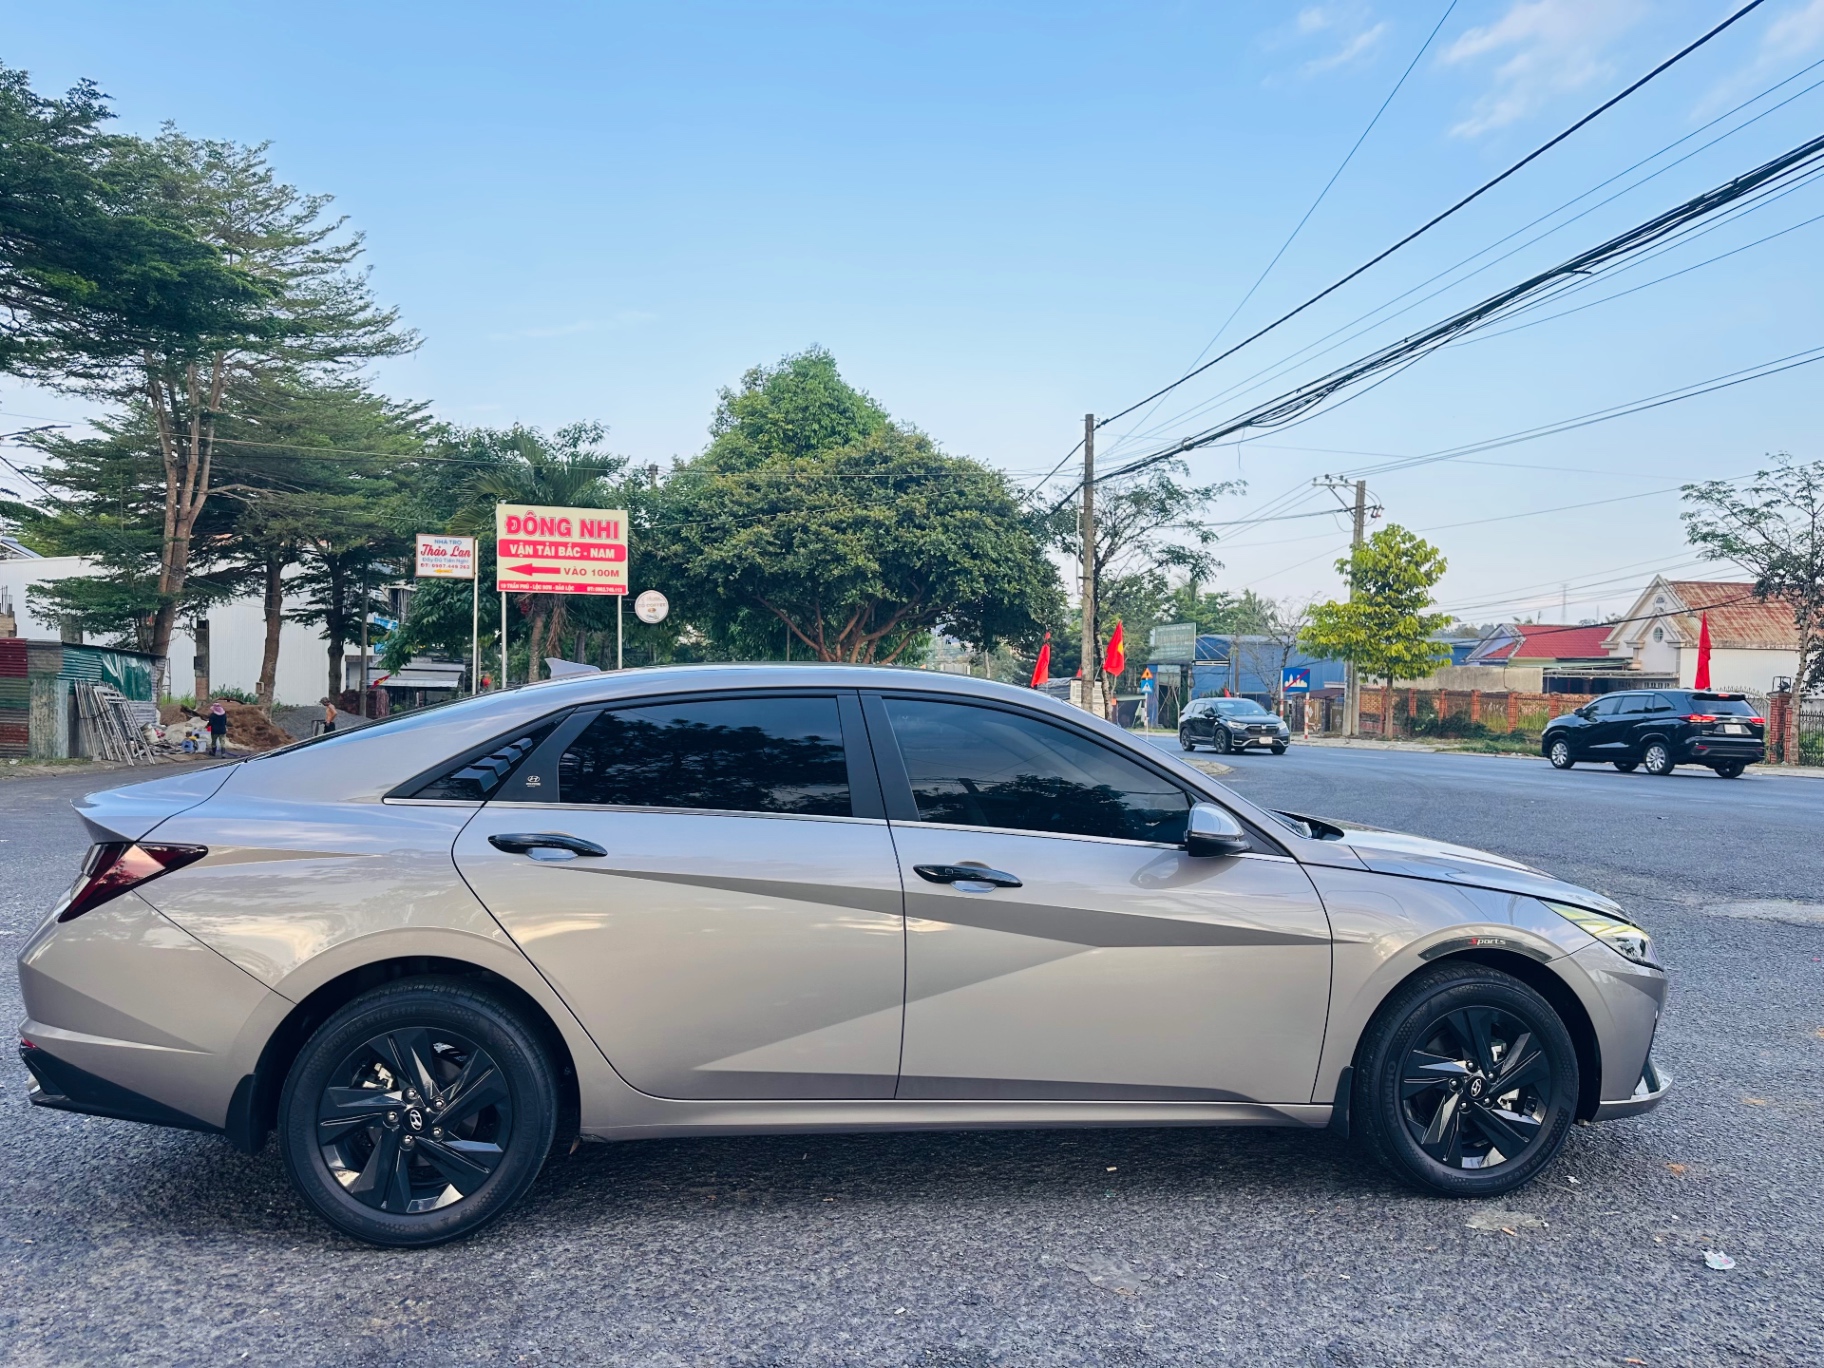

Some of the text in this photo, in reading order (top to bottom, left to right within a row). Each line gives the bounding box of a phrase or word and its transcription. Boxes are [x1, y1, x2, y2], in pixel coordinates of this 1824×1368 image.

[505, 510, 620, 540] ĐÔNG NHI
[420, 543, 471, 558] Thảo Lan
[509, 542, 534, 558] VẬN
[536, 542, 556, 557] TẢI
[558, 543, 581, 557] BẮC
[590, 548, 615, 559] NAM
[563, 566, 620, 578] VÀO 100M
[1384, 1060, 1399, 1127] KUMHO
